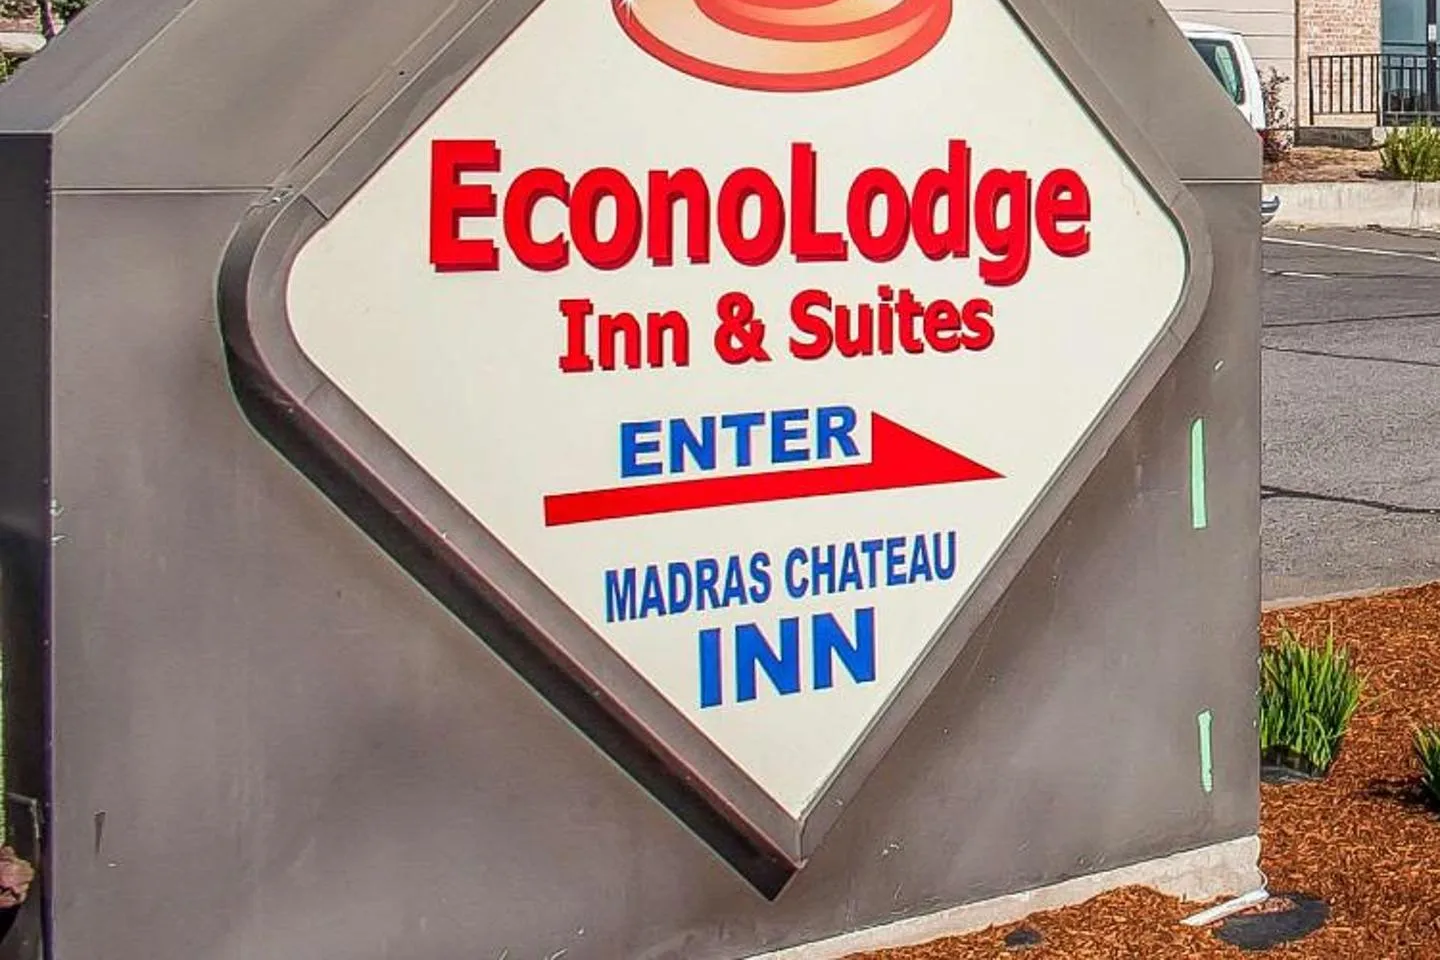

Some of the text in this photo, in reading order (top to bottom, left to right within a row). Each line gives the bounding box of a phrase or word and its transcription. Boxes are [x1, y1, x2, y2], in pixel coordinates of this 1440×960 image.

[429, 139, 1092, 286] EconoLodge
[558, 285, 996, 374] Inn & Suites
[619, 405, 861, 479] ENTER
[604, 531, 957, 623] MADRAS CHATEAU
[699, 607, 876, 709] INN
